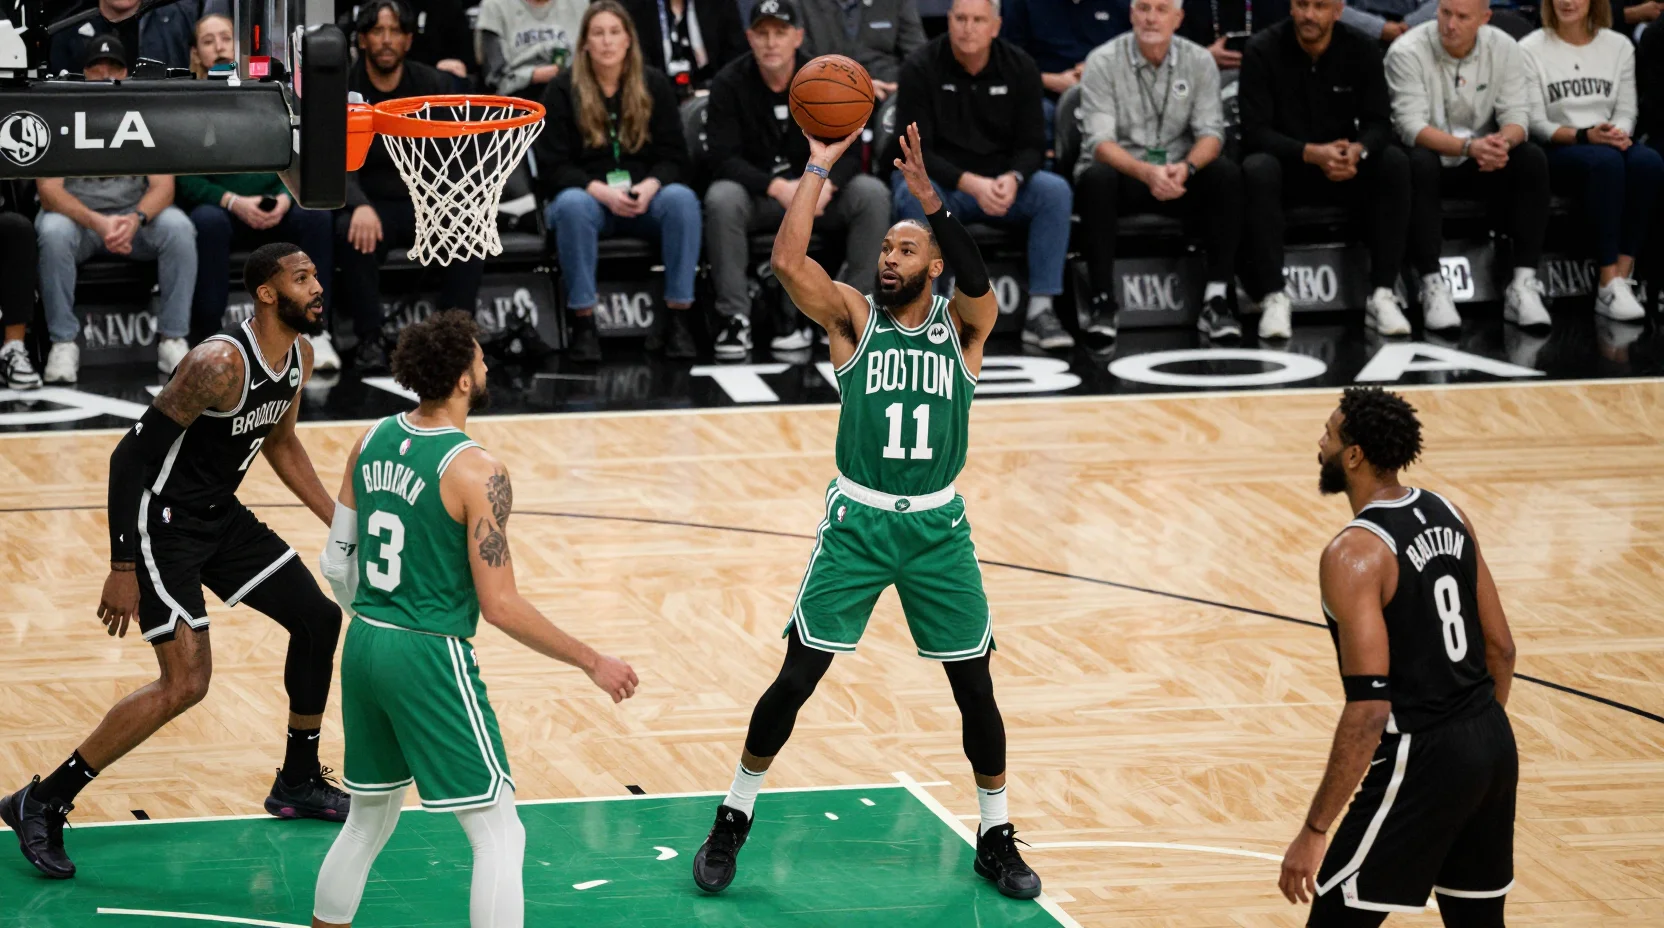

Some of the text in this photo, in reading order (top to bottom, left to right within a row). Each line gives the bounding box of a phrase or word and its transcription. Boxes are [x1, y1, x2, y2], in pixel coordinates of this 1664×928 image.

[866, 348, 955, 400] BOSTON
[883, 403, 933, 460] 11
[366, 510, 405, 593] 3
[1434, 575, 1468, 662] 8
